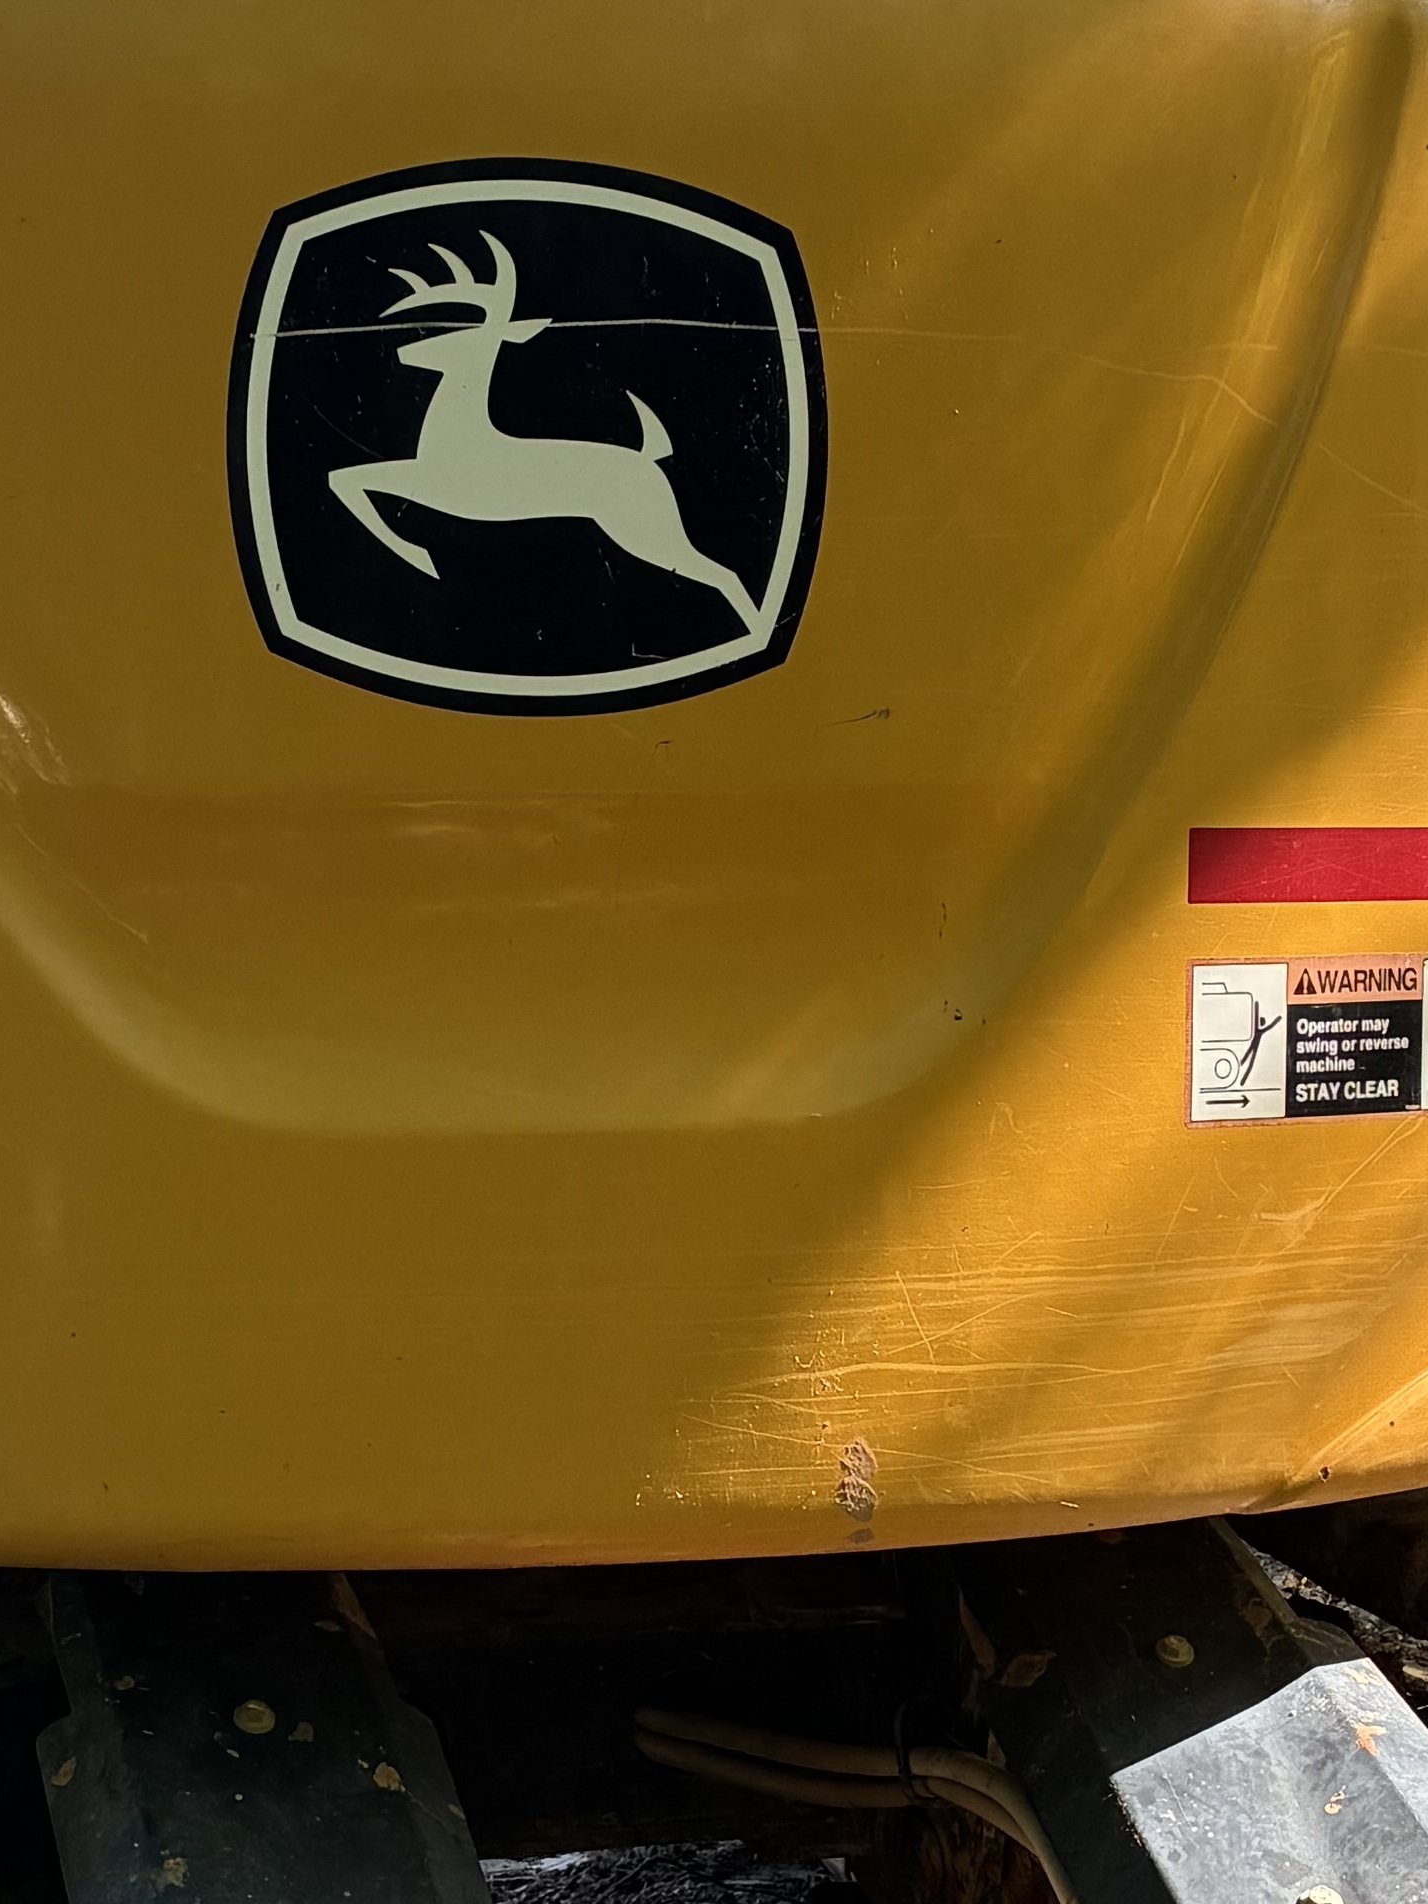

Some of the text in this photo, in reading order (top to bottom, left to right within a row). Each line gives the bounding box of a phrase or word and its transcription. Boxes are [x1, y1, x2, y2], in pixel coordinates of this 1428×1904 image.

[1317, 967, 1418, 994] WARNING
[1296, 1018, 1390, 1037] Operator may
[1296, 1036, 1410, 1056] swing or reverse
[1296, 1056, 1356, 1074] machine
[1295, 1079, 1399, 1103] STAY CLEAR
